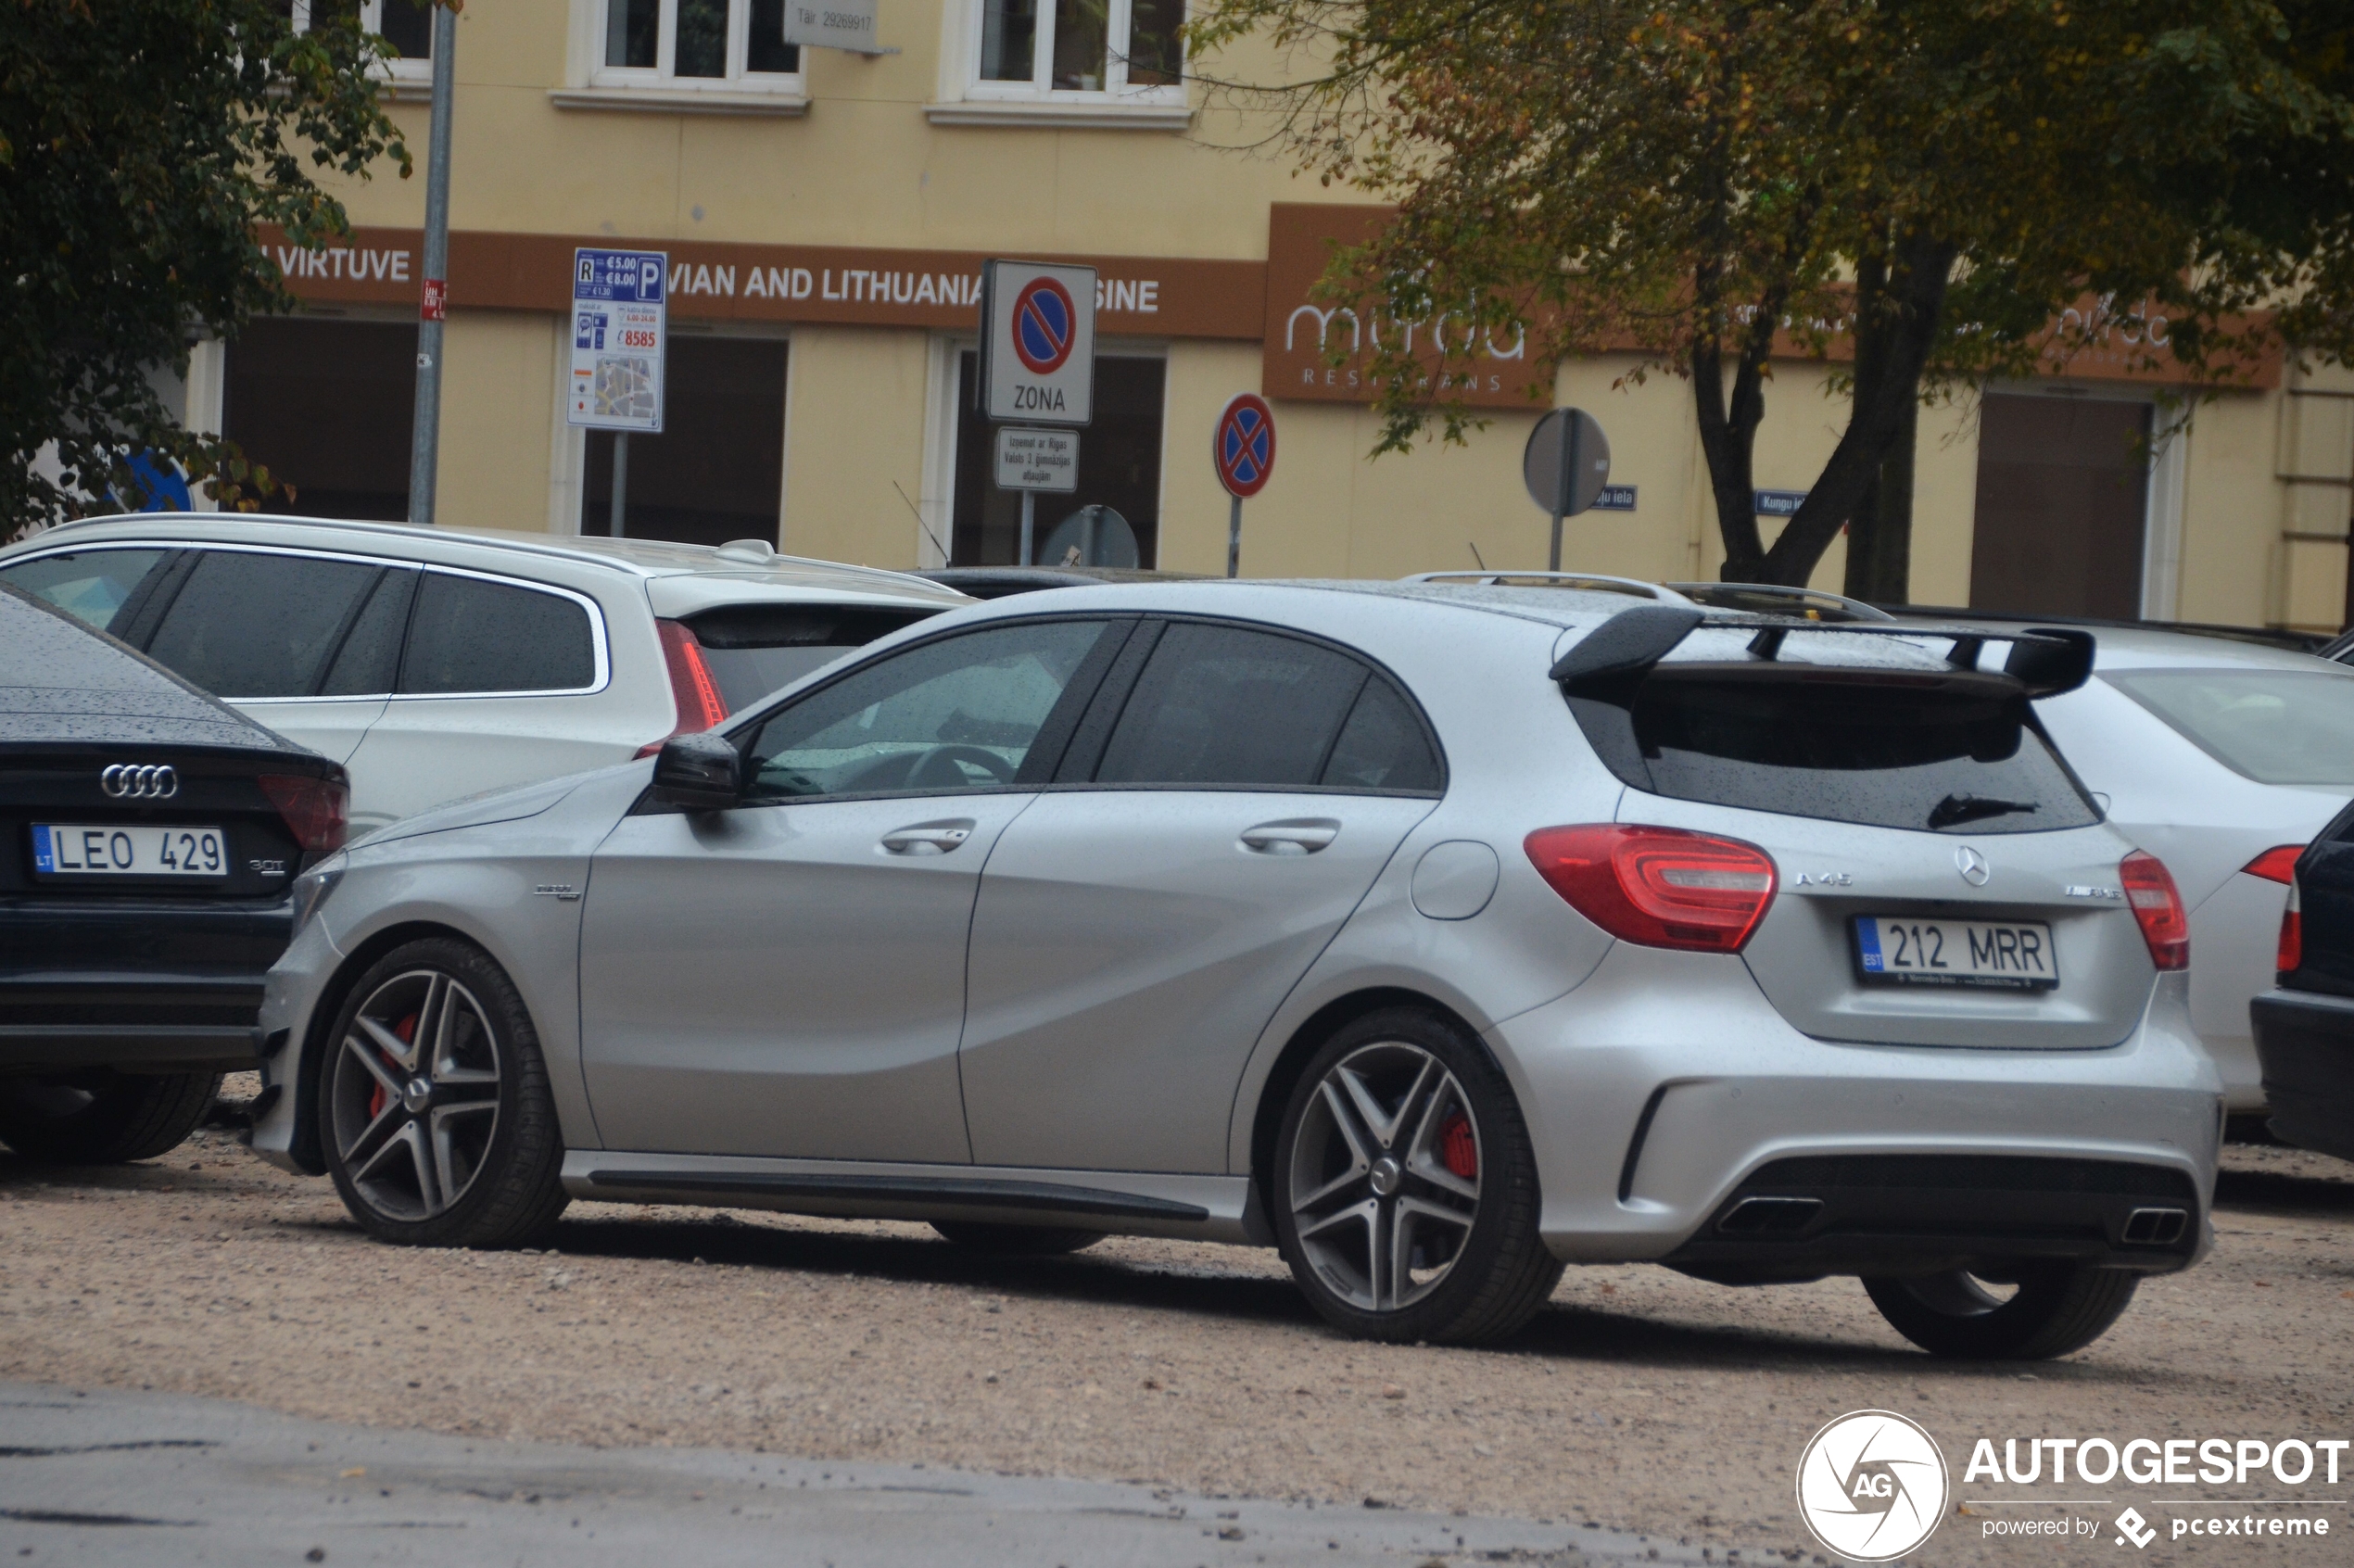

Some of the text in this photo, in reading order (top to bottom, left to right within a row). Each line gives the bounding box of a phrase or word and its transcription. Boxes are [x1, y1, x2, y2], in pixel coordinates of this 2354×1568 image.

[823, 11, 871, 31] 29269917
[278, 245, 410, 282] VIRTUVE
[744, 266, 813, 299] AND
[625, 331, 656, 348] 8585
[1014, 385, 1066, 411] ZONA
[1614, 489, 1633, 504] iela
[1764, 495, 1792, 512] Kungu
[56, 830, 221, 871] LEO 429
[36, 855, 51, 866] LT
[1796, 871, 1853, 886] A 45
[1890, 924, 2045, 972] 212 MRR
[1865, 953, 1882, 967] EST
